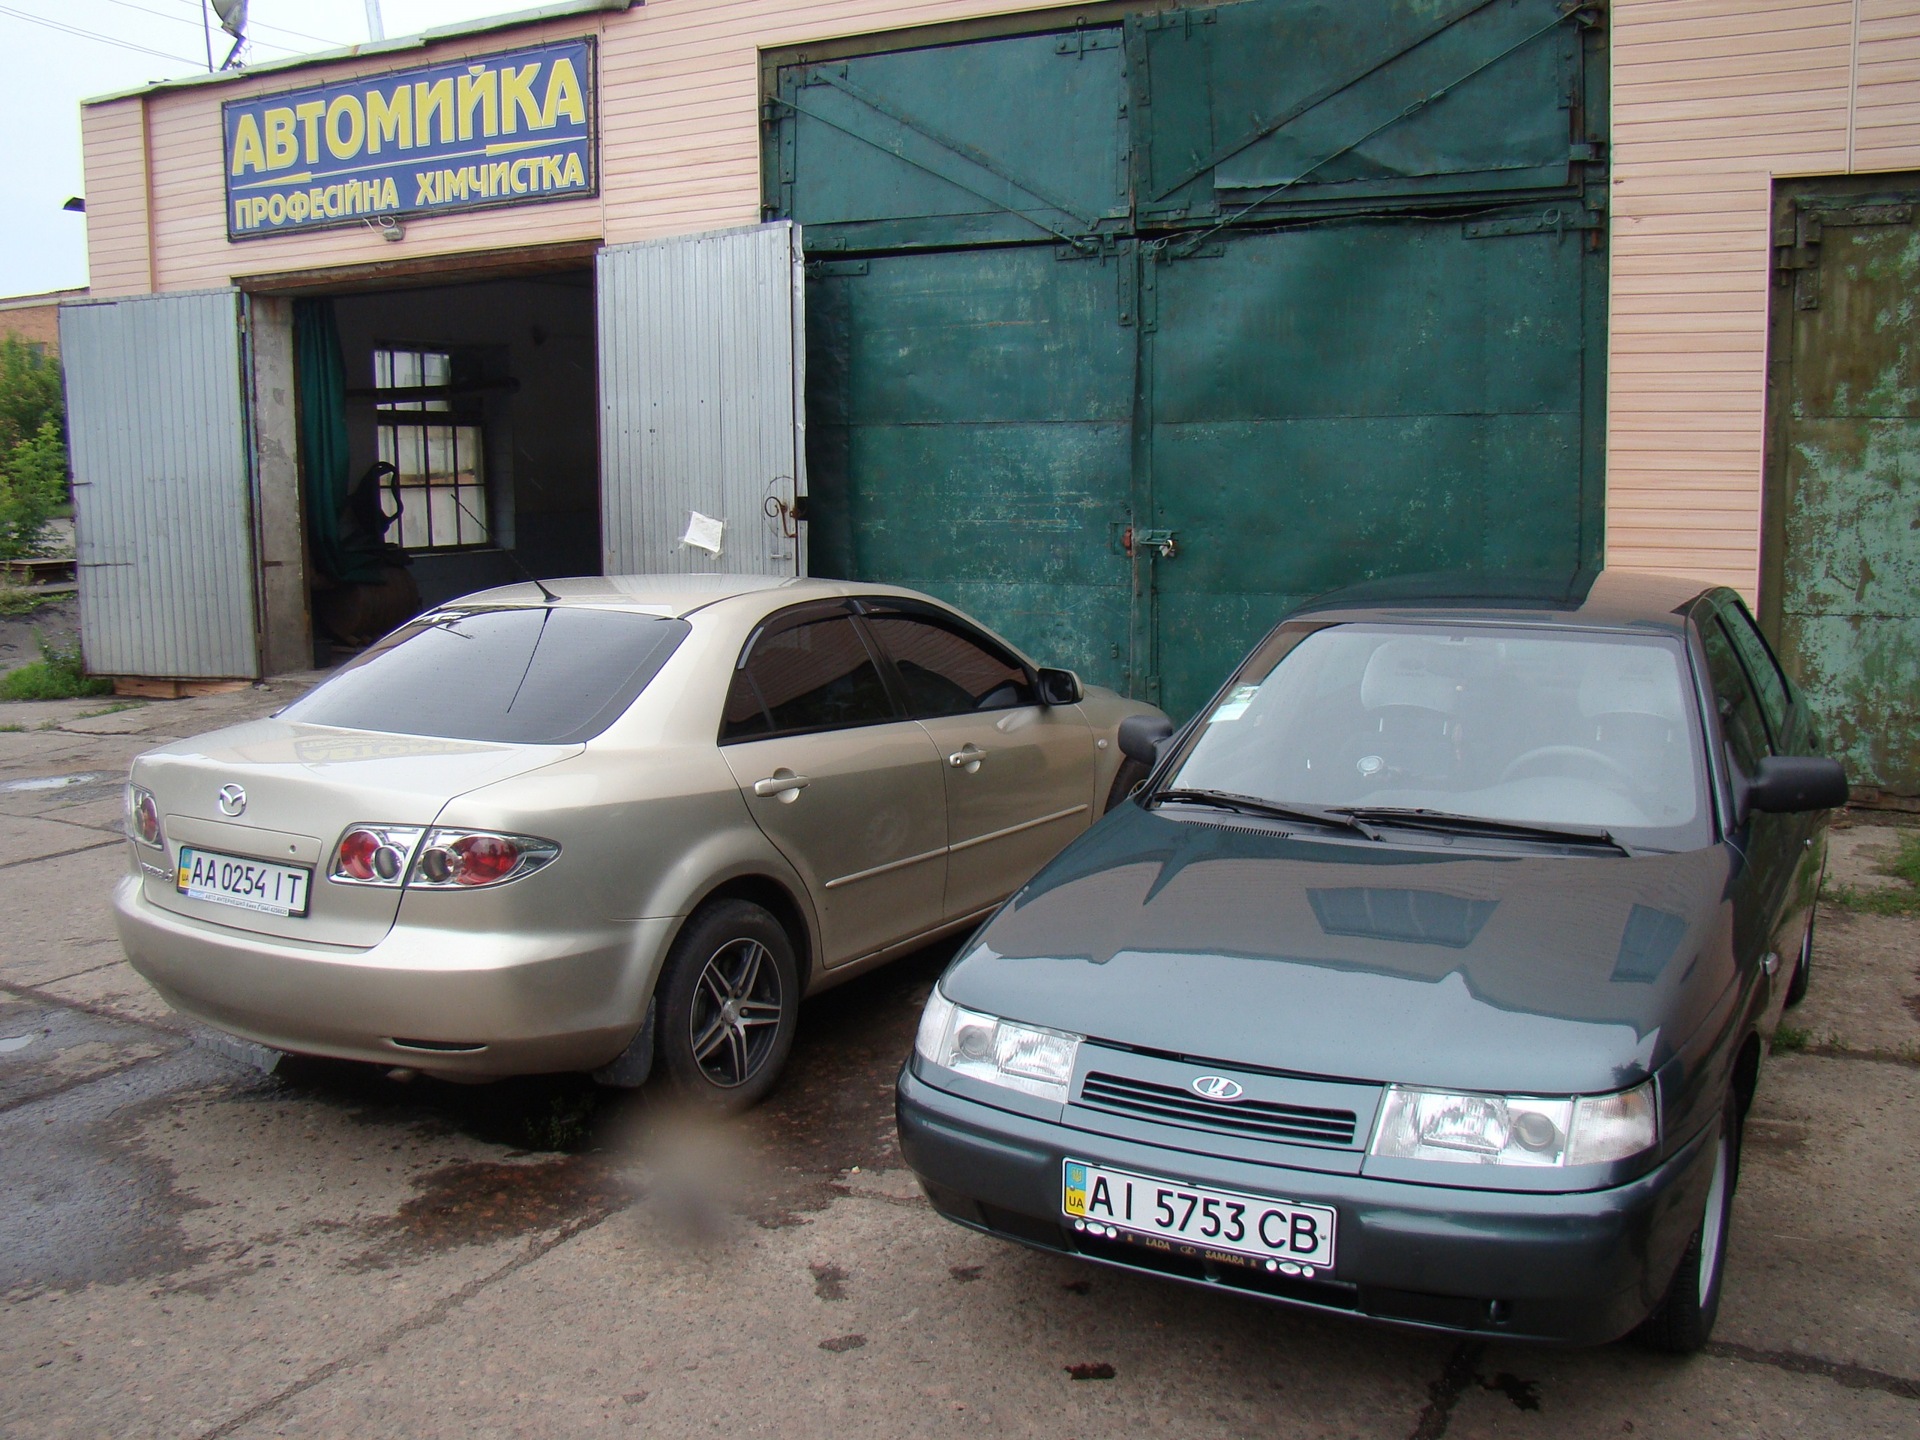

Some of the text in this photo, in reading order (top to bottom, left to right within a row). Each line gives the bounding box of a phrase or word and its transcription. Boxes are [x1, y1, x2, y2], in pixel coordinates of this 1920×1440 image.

[231, 57, 586, 176] АВТОМИЙКА
[235, 152, 585, 229] ПРОФЕСІЙНА ХІМЧИСТКА
[221, 862, 267, 898] 0254
[1068, 1196, 1085, 1210] UA
[1088, 1175, 1319, 1254] AI 5753 CB
[1145, 1237, 1245, 1266] LADA SAMARA
